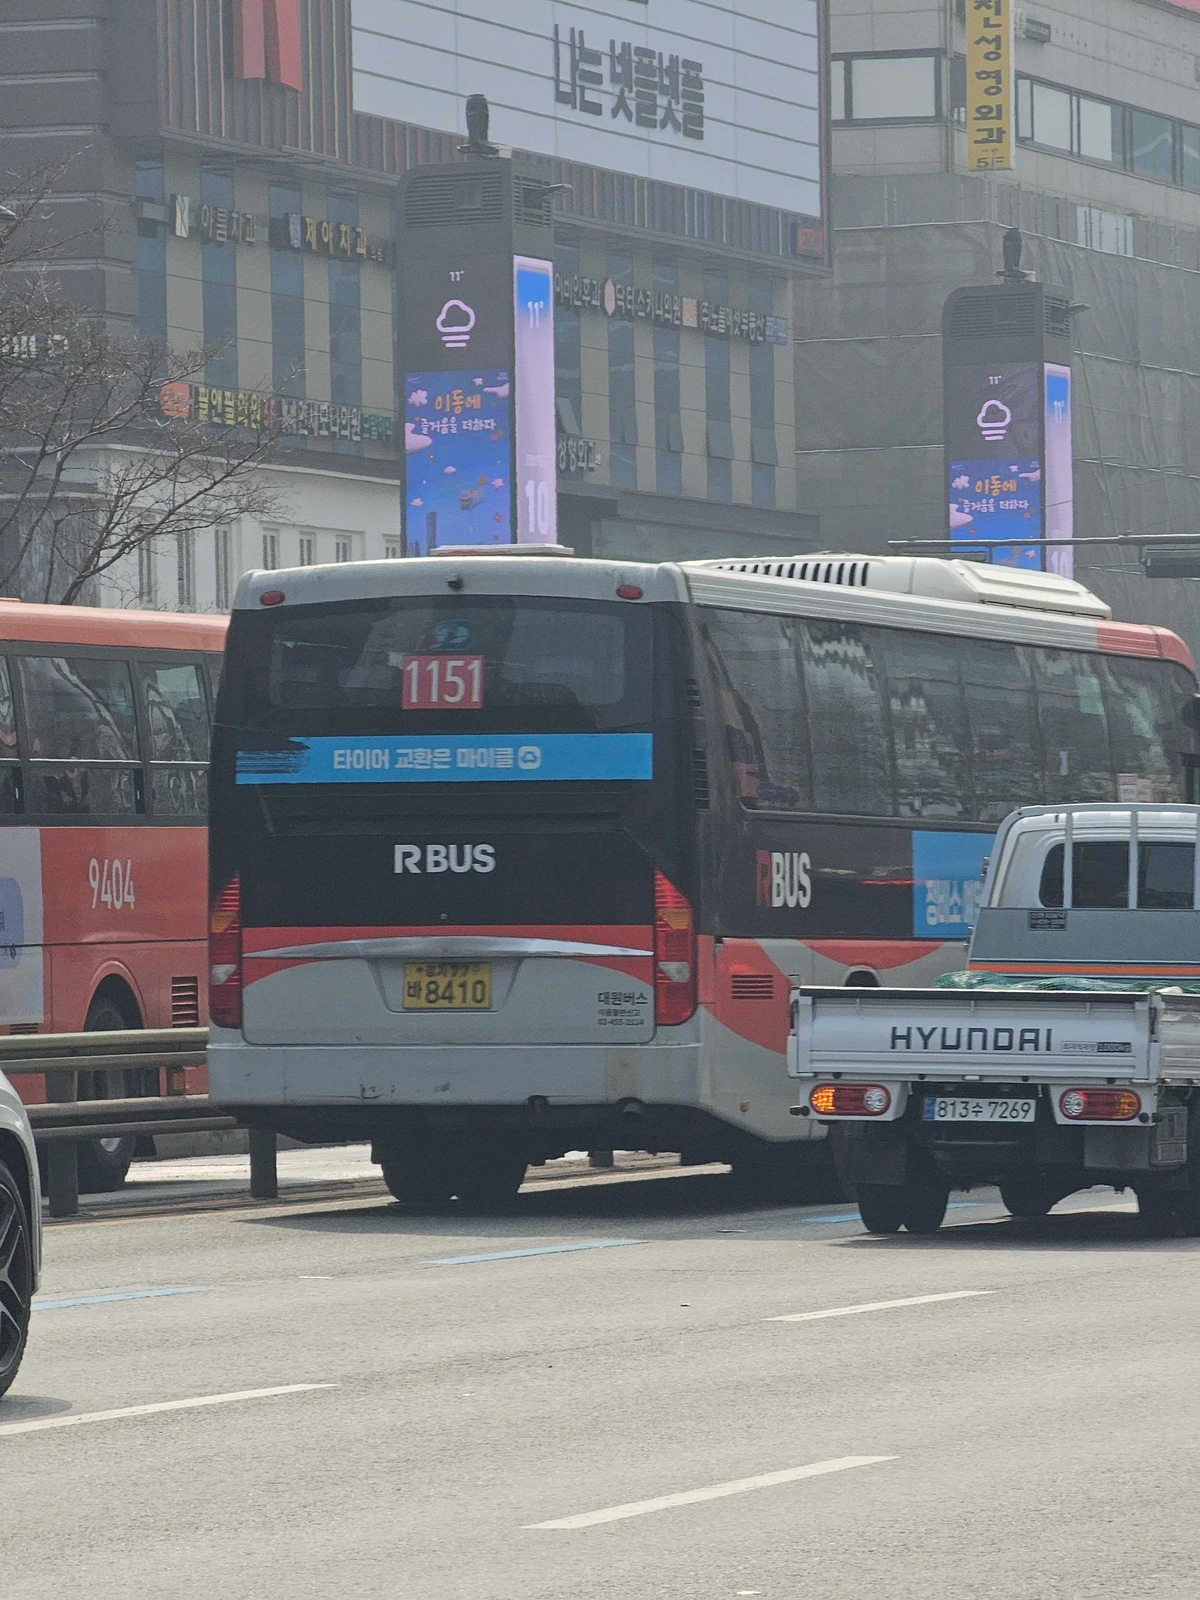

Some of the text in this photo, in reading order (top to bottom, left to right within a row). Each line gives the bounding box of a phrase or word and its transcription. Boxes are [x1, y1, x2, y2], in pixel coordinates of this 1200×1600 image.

[554, 23, 603, 116] 나는
[555, 272, 601, 310] 이비인후과
[435, 389, 482, 414] 이동에
[420, 416, 496, 434] 즐거움을 더하다
[975, 475, 1017, 496] 이동에
[525, 479, 550, 535] 10
[962, 500, 1029, 513] 즐거움을 더하다
[406, 660, 481, 703] 1151
[333, 747, 515, 769] 타이어 교환은 마이클
[89, 857, 135, 910] 9404
[756, 849, 812, 908] RBUS
[598, 991, 648, 1006] 대원버스
[891, 1026, 1053, 1051] HYUNDAI
